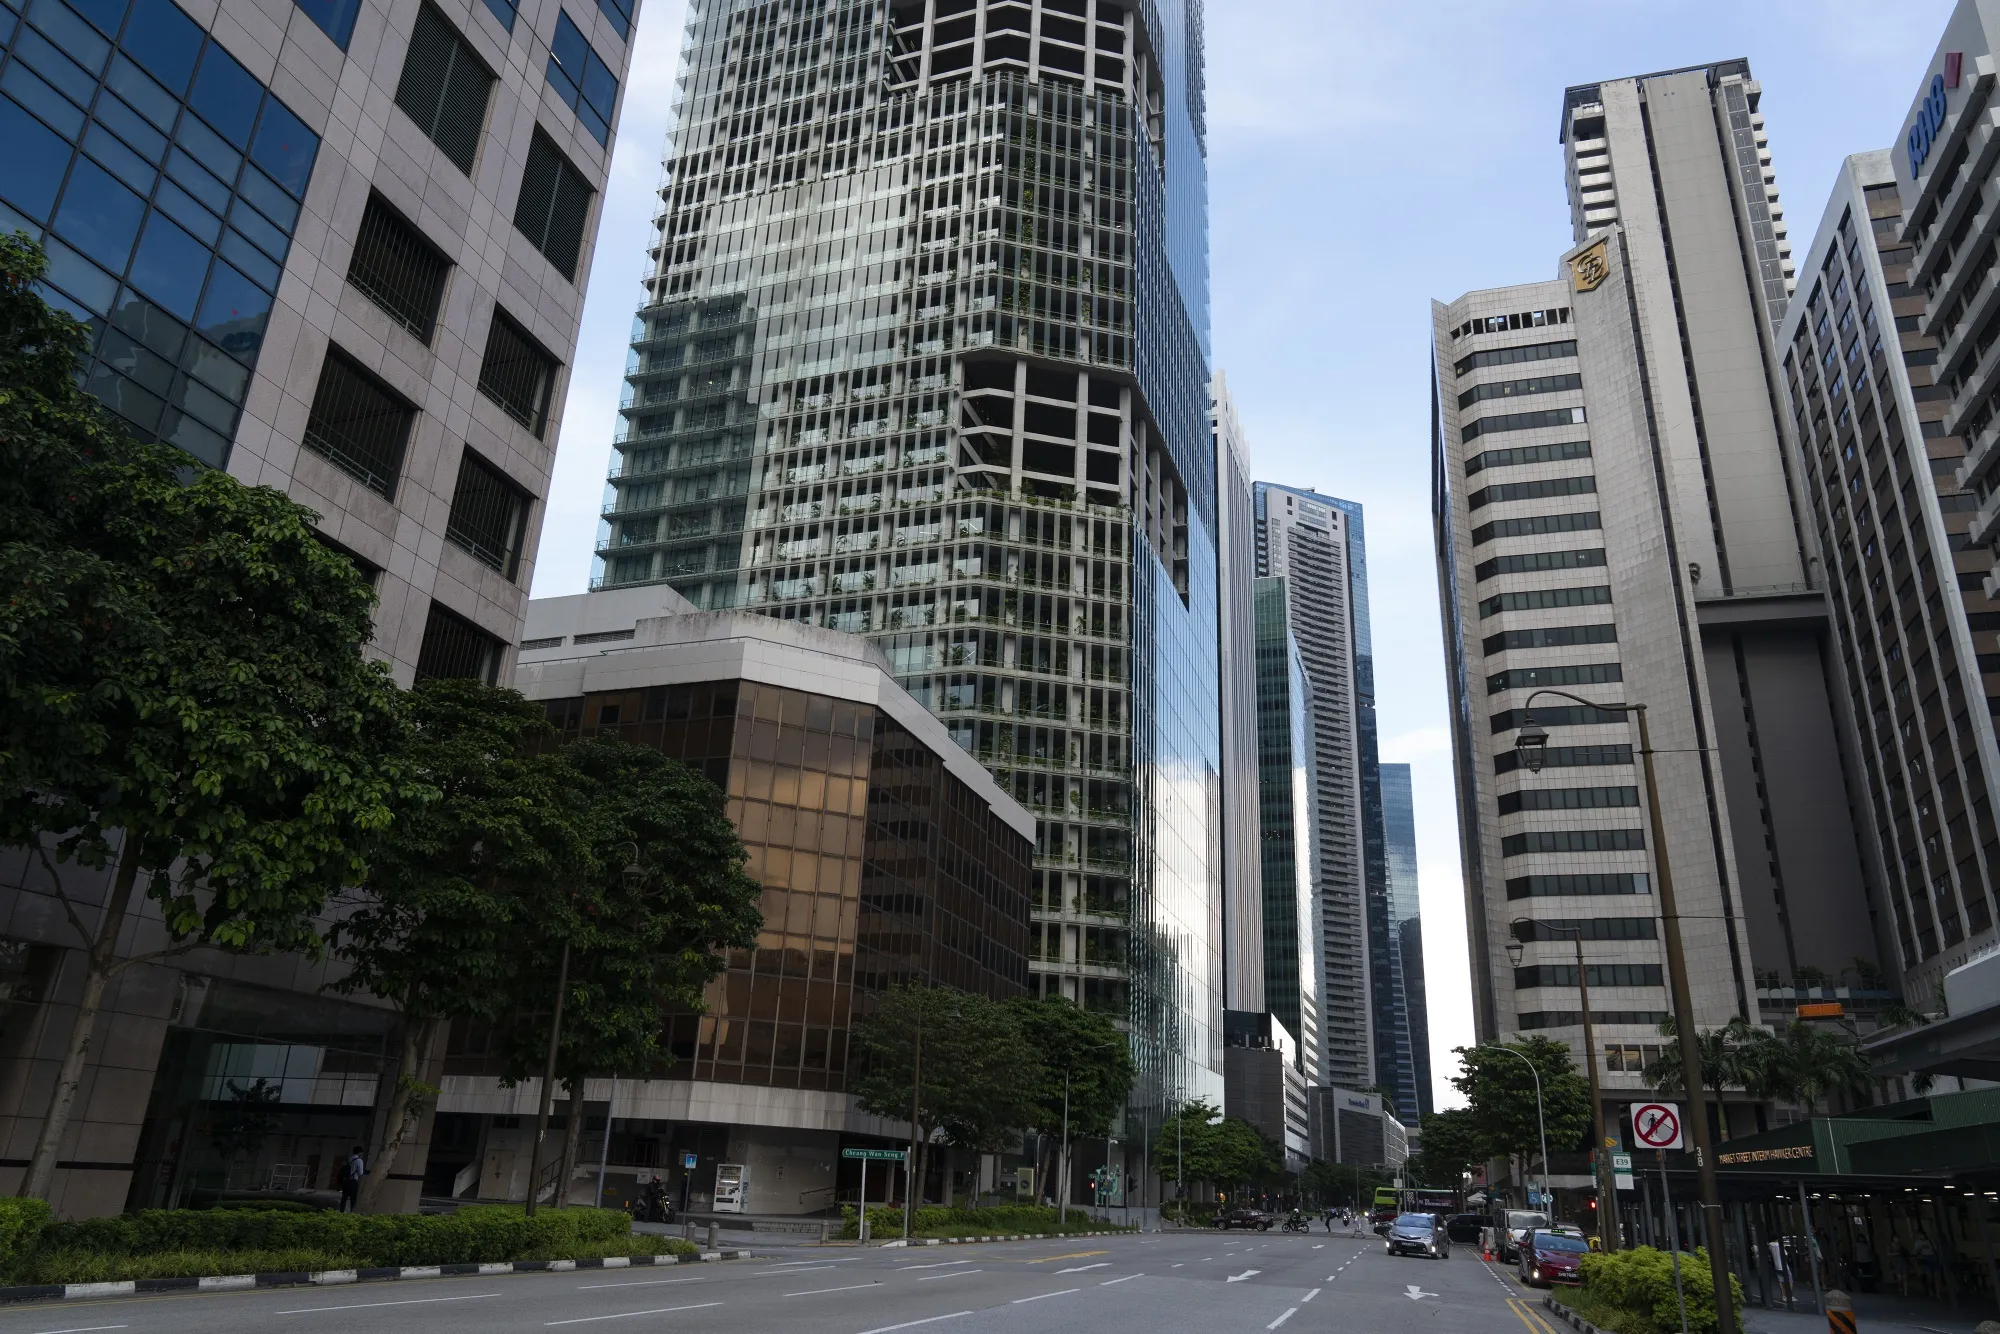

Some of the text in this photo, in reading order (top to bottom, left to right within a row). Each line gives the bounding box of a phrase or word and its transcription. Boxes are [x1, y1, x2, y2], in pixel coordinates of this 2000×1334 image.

[1907, 73, 1947, 180] RHB
[845, 1149, 867, 1157] Cheang
[883, 1151, 898, 1159] Seng
[1615, 1158, 1629, 1166] E39
[1696, 1146, 1704, 1167] 38
[1718, 1145, 1815, 1165] MARKET STREET INTERIM HAWKER CENTRE
